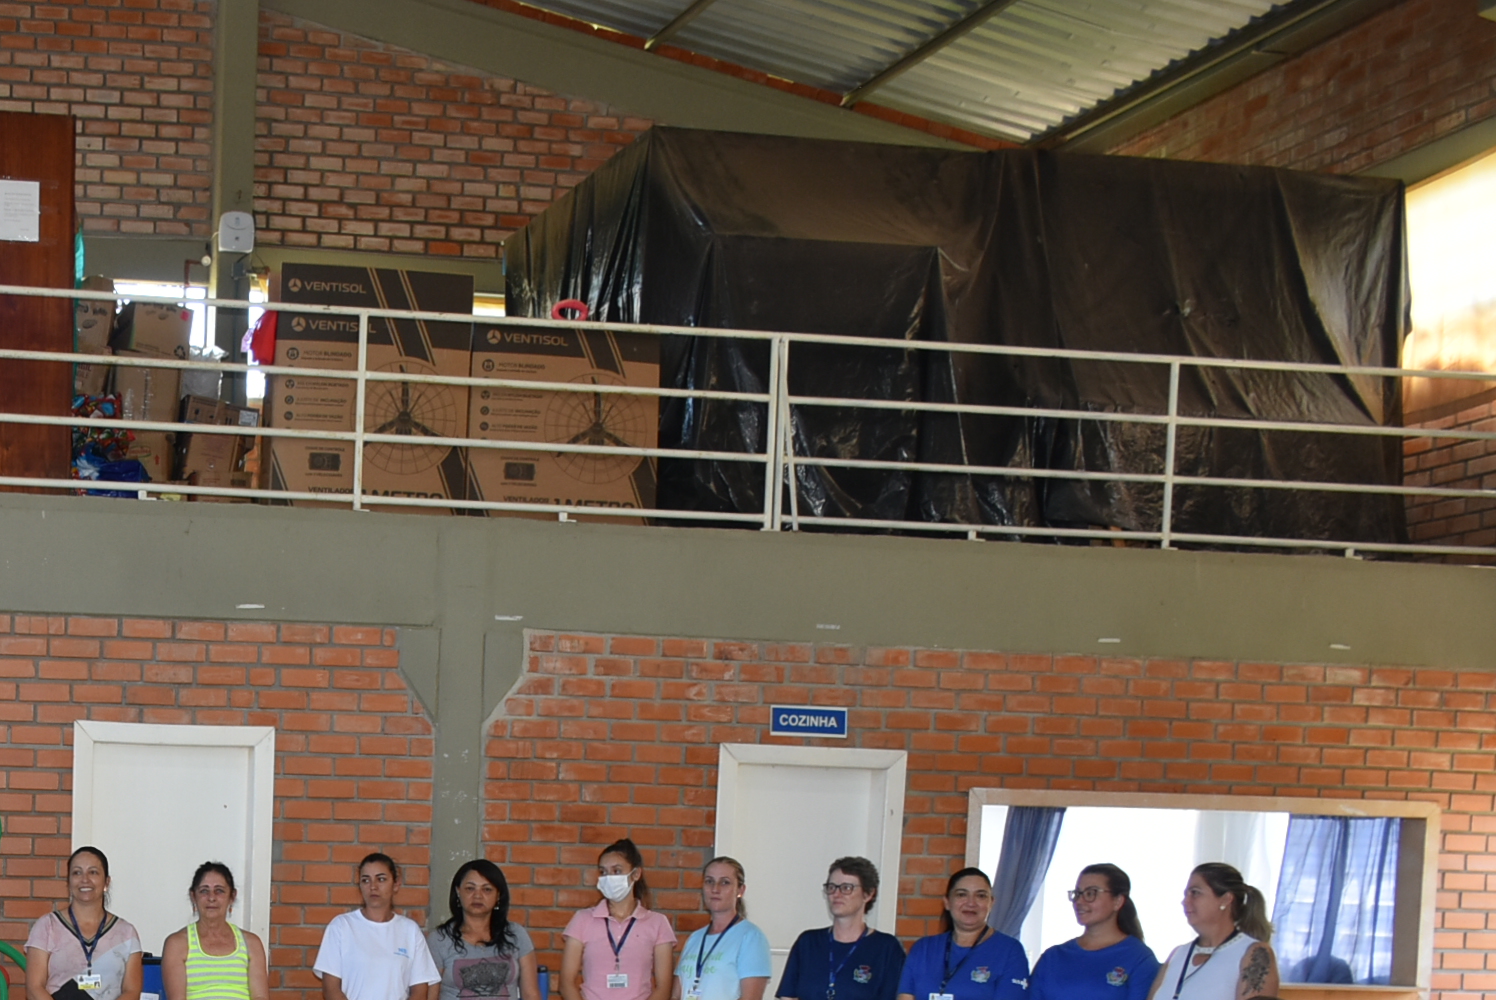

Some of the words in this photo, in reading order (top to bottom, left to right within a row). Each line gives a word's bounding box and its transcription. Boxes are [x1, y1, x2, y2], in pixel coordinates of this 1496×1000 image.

[304, 281, 367, 294] VENTISOL
[309, 320, 377, 334] VENTISL
[503, 332, 569, 347] VENTISOL
[779, 713, 838, 728] COZINHA
